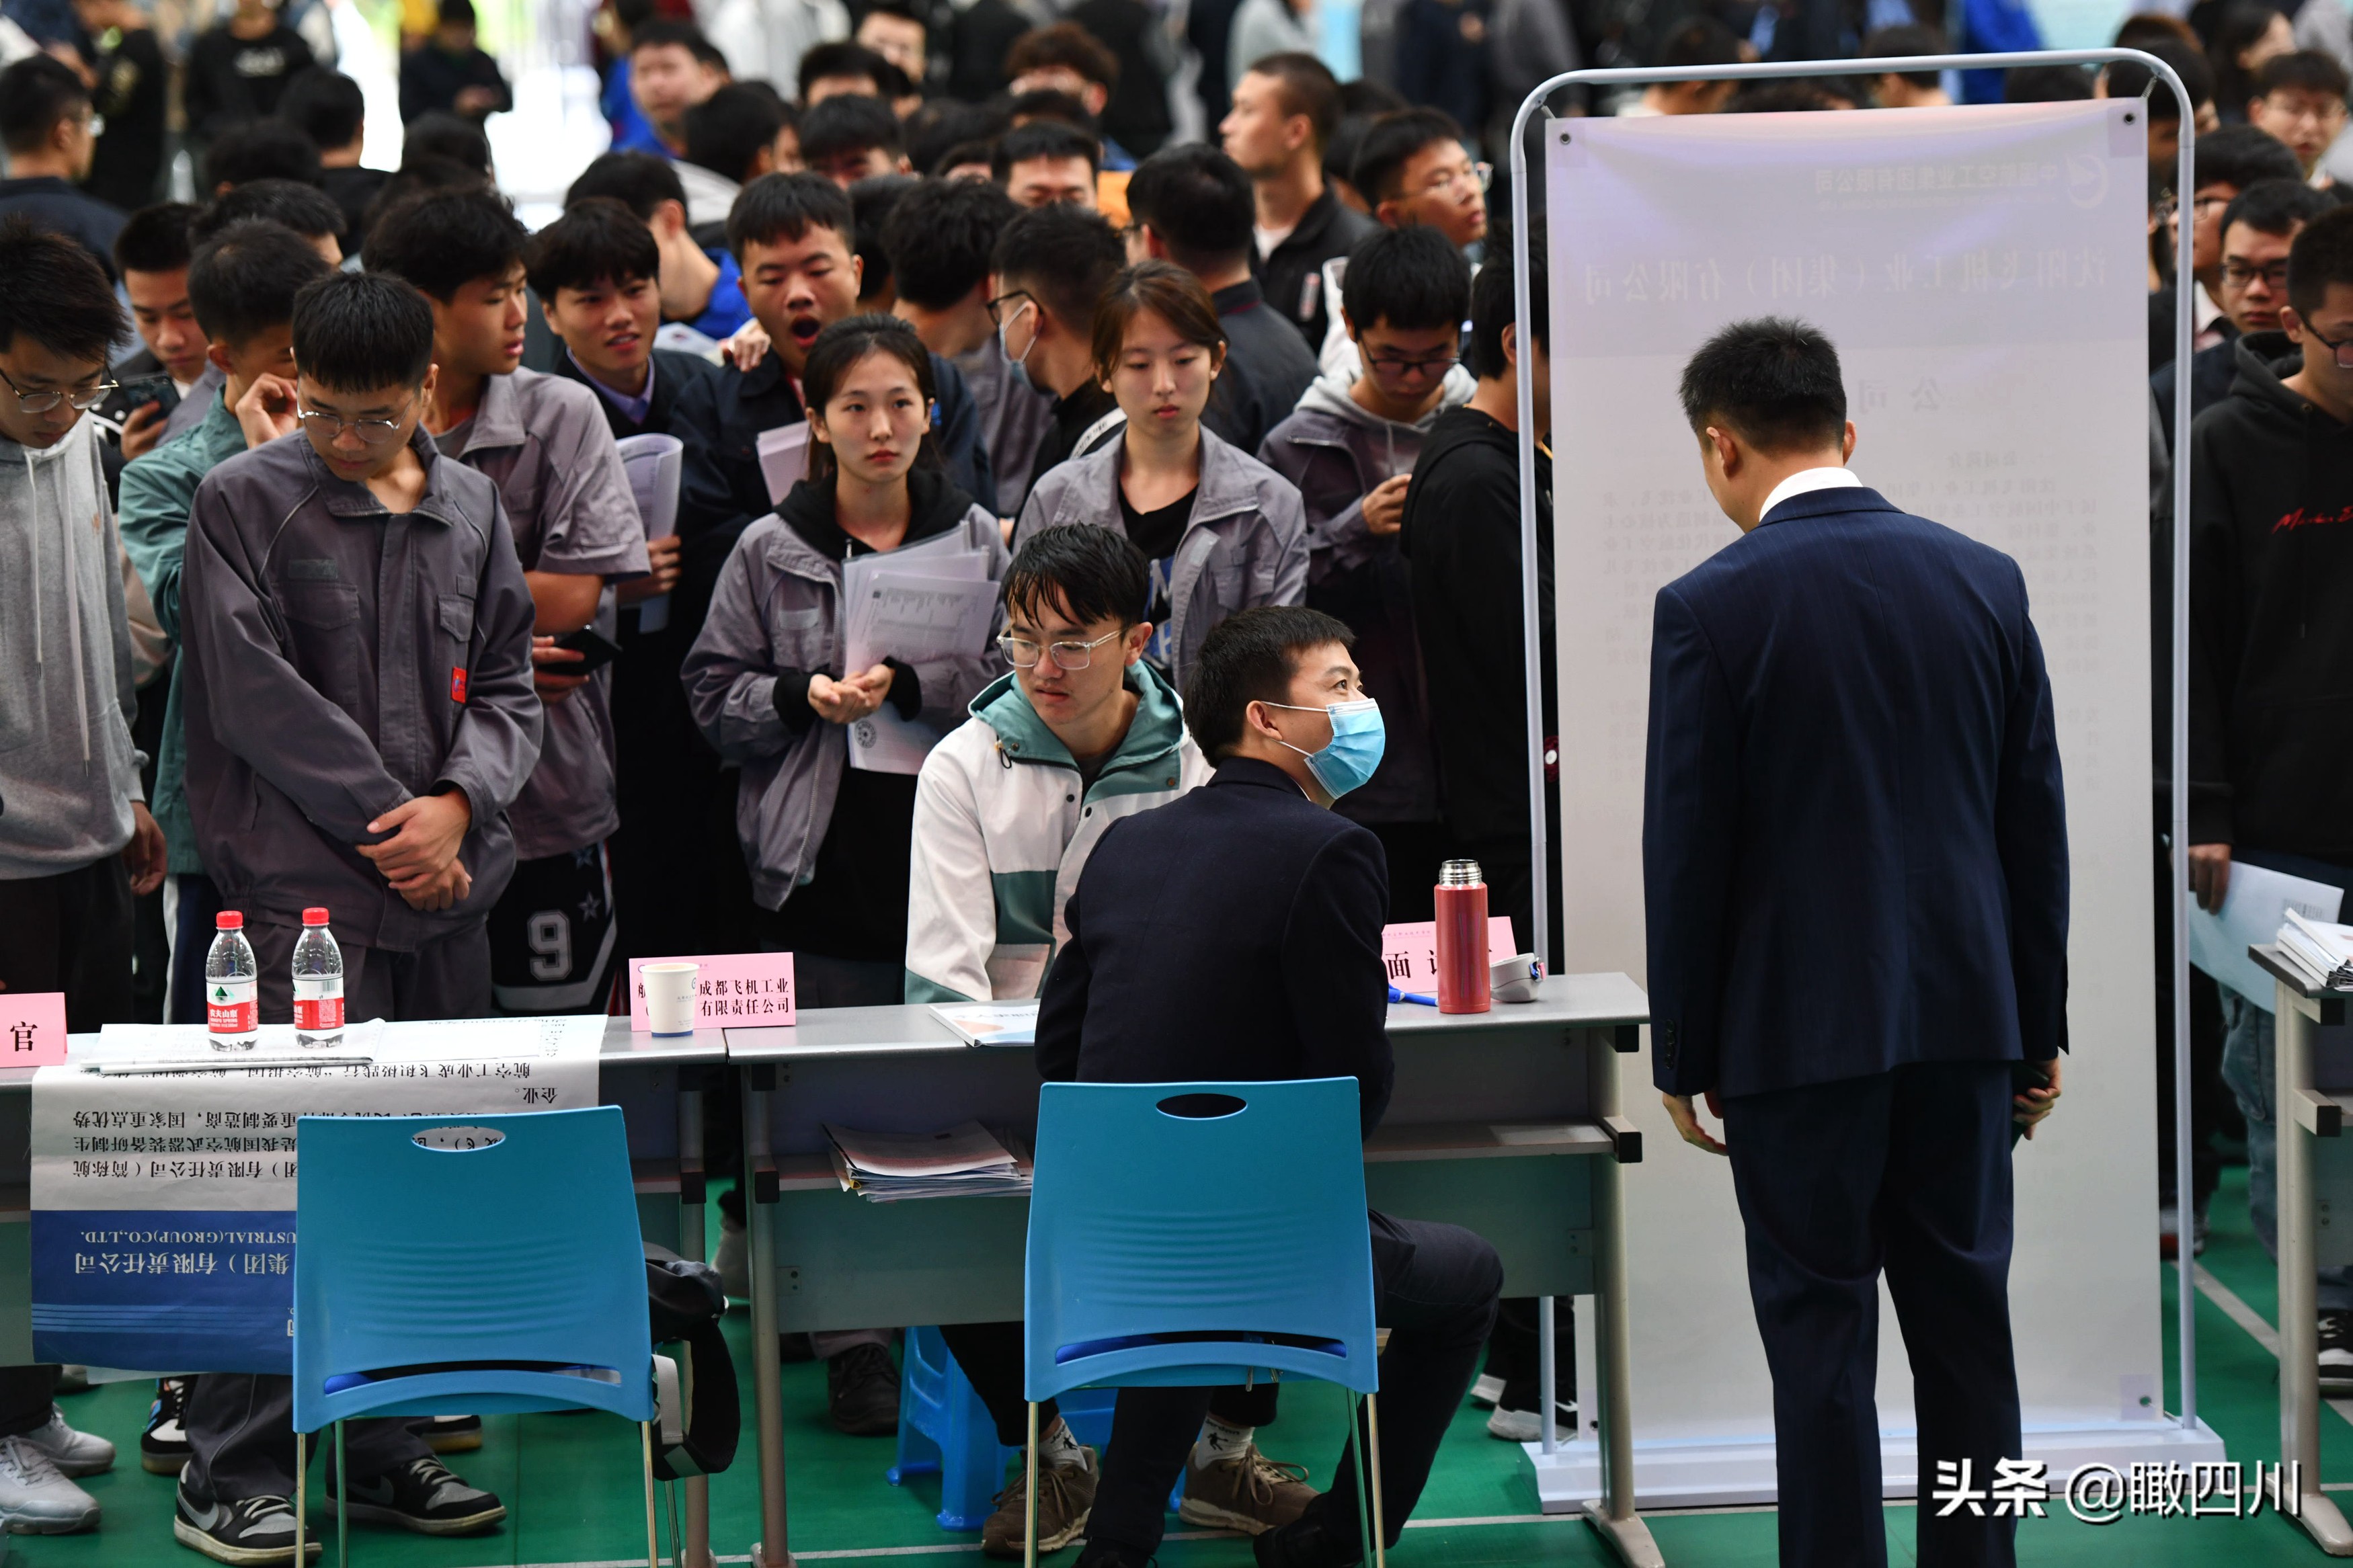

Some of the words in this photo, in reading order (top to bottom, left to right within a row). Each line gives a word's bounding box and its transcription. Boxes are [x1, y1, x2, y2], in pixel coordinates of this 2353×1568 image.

[527, 909, 572, 982] 9
[699, 978, 789, 997] 成都飞机工业
[701, 998, 789, 1016] 有限责任公司
[9, 1021, 38, 1052] 官
[515, 1087, 558, 1105] 企业。
[73, 1136, 296, 1153] 是我国航空武器装备研制生
[75, 1252, 289, 1275] 集团）有限责任公司
